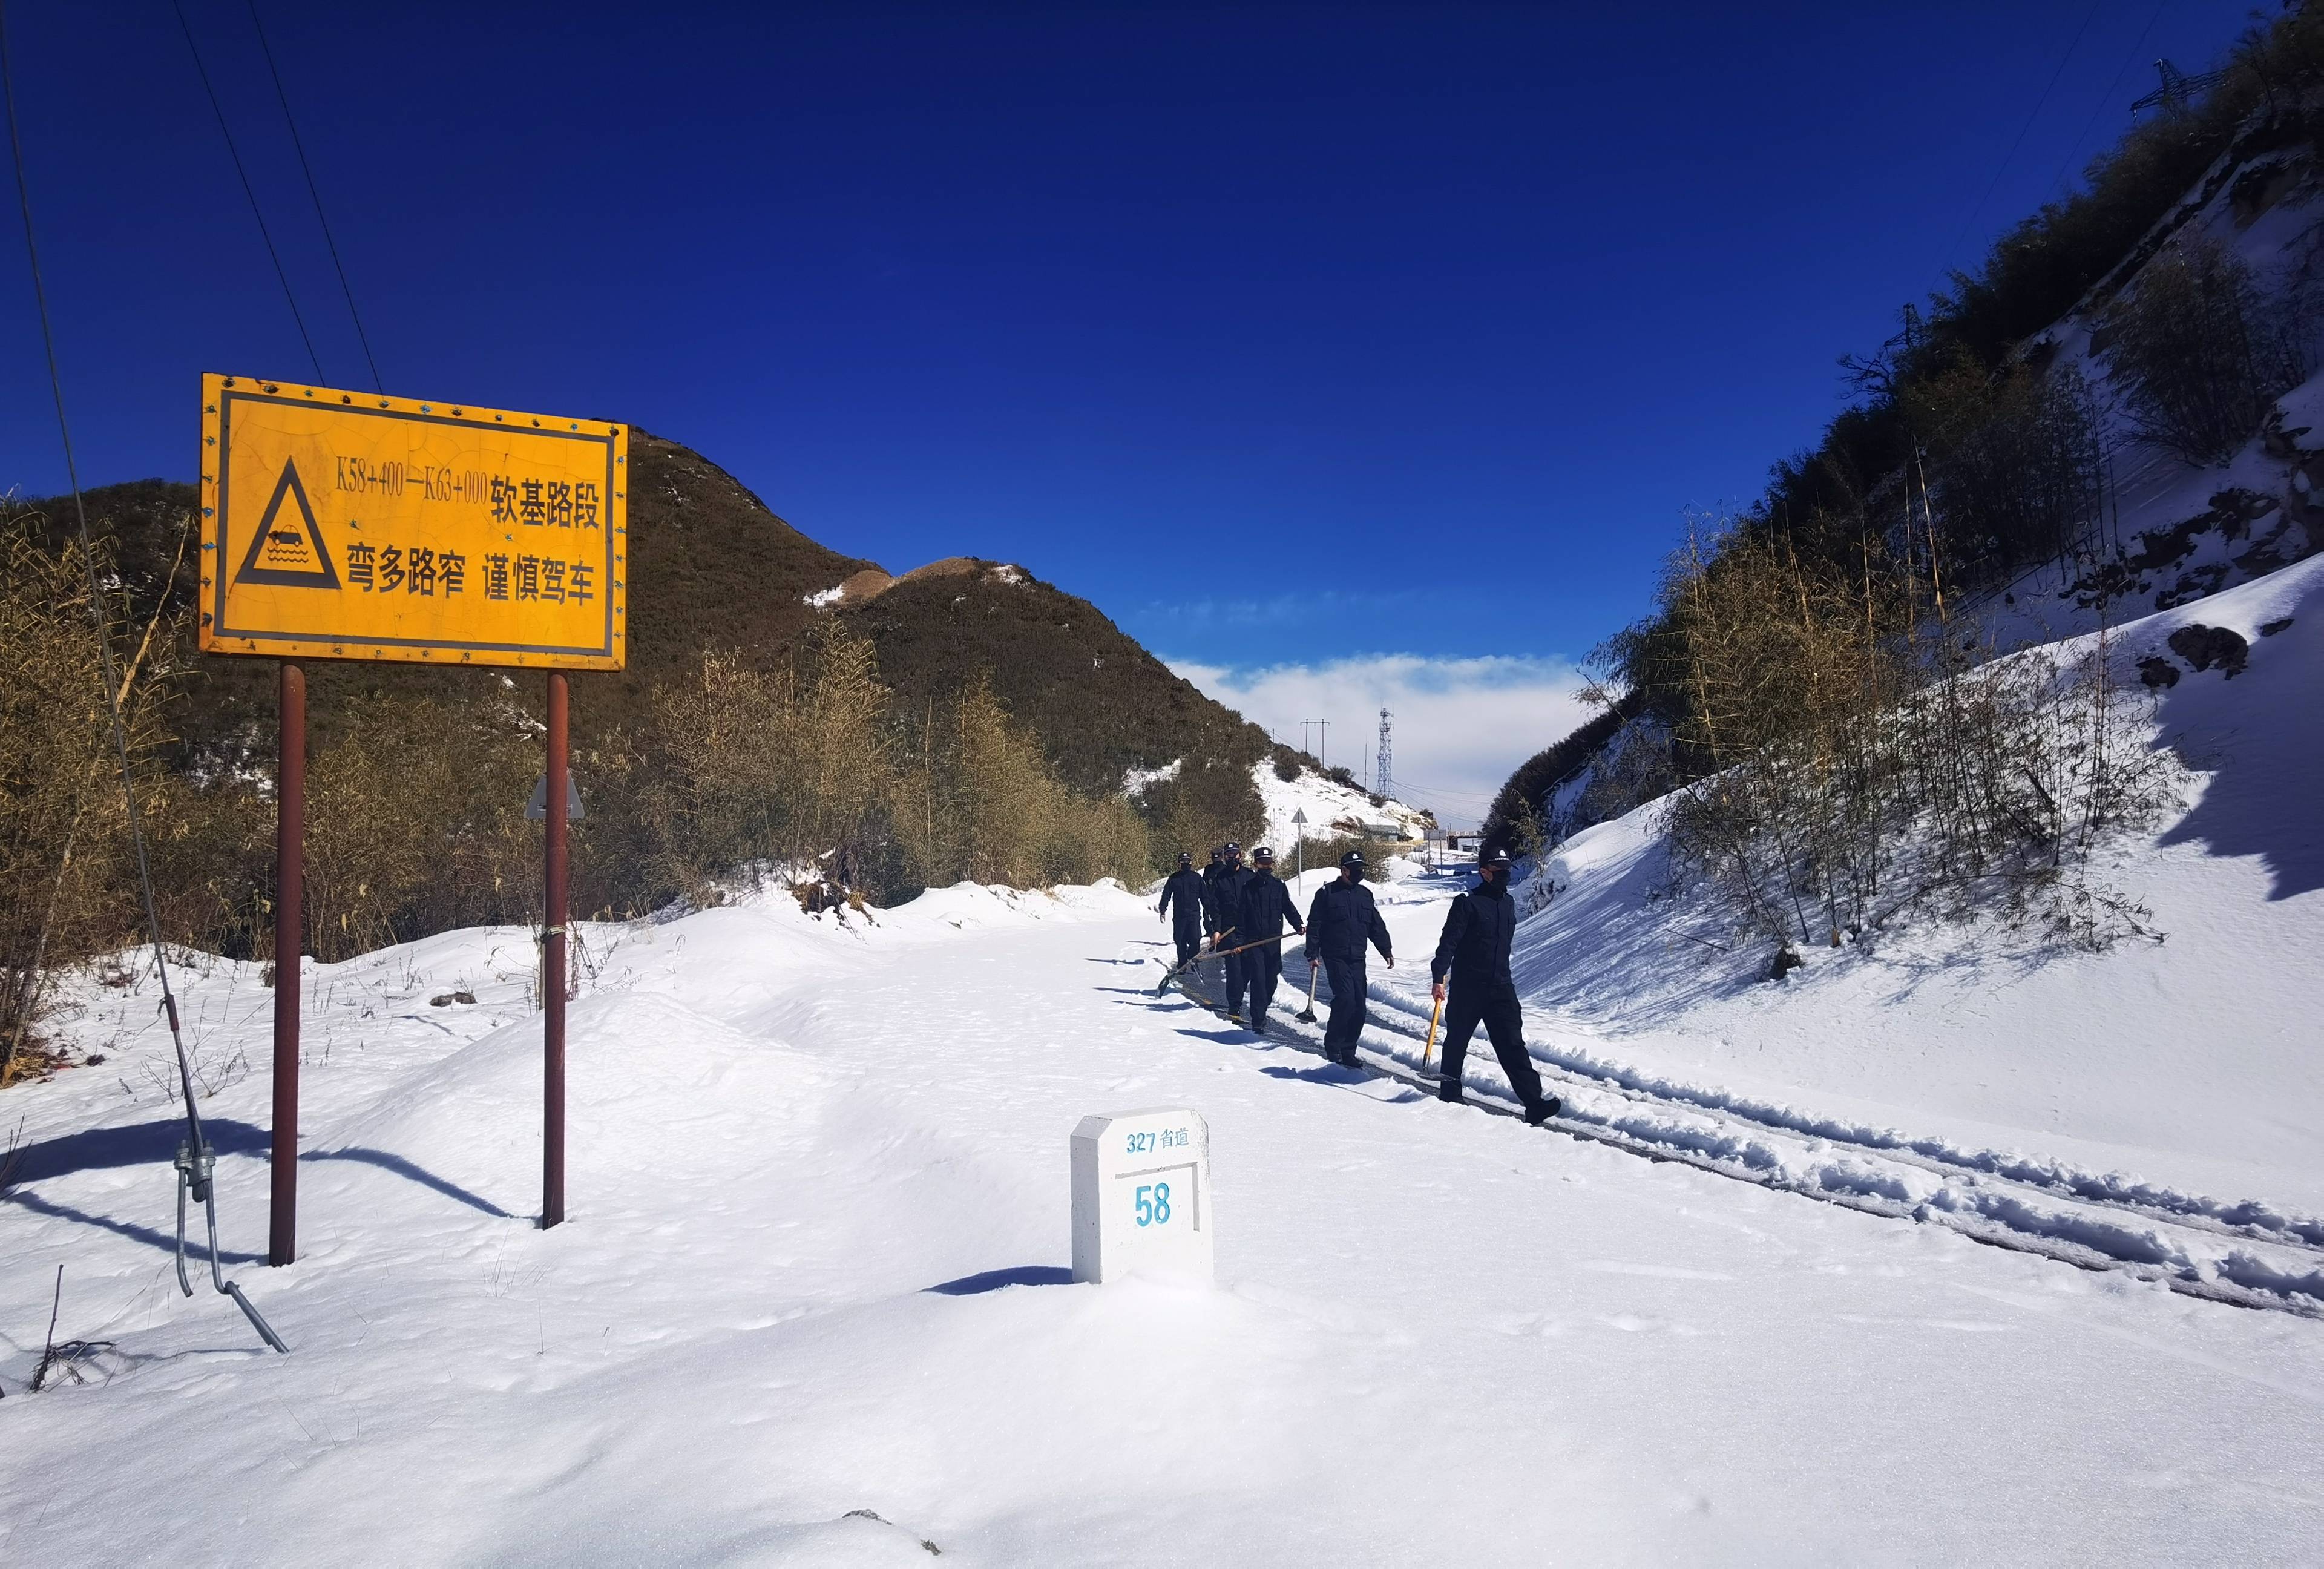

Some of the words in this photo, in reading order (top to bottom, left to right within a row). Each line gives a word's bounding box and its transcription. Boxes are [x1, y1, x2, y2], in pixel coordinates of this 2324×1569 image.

[347, 541, 465, 599] 弯多路窄
[482, 551, 594, 606] 谨慎驾车
[1126, 1133, 1155, 1153] 327
[1160, 1127, 1189, 1149] 省道
[1135, 1182, 1170, 1227] 58
